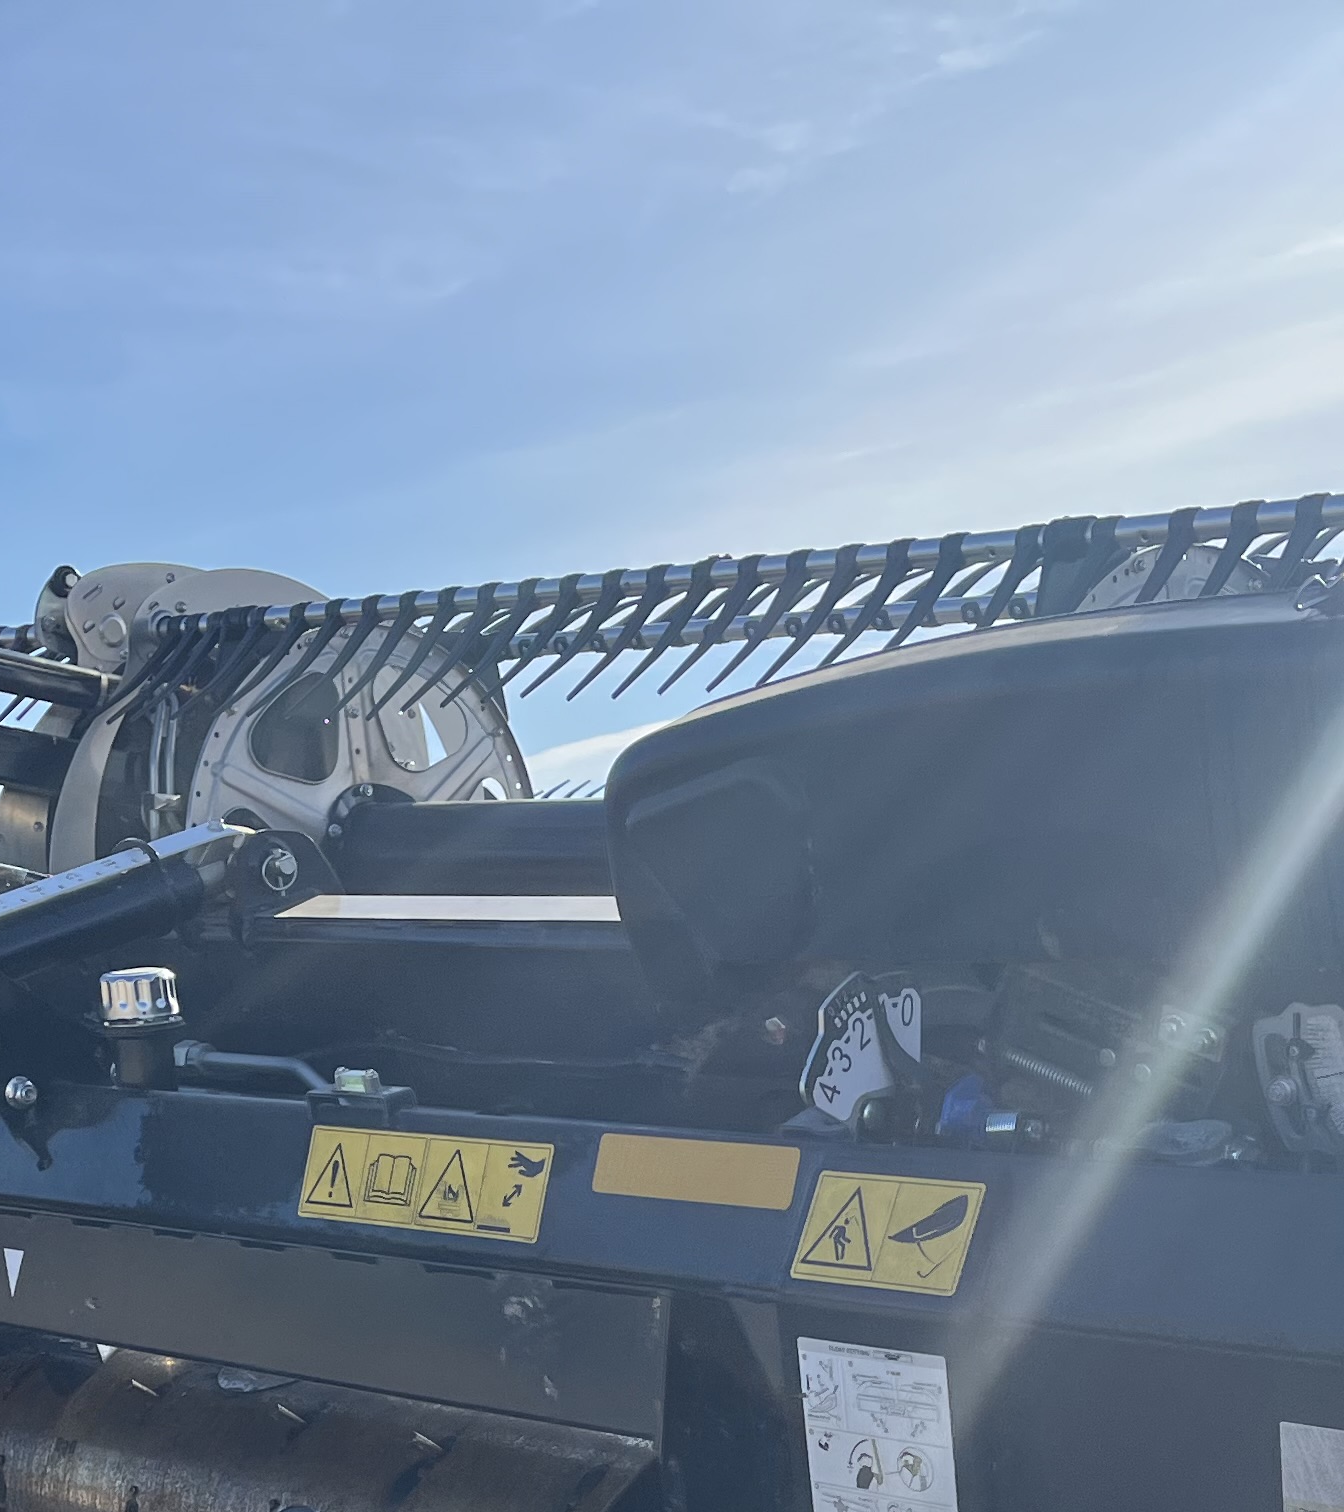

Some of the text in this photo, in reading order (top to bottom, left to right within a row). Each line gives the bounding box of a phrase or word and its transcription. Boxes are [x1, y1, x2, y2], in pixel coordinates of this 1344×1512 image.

[818, 993, 914, 1104] 4 3 2 0
